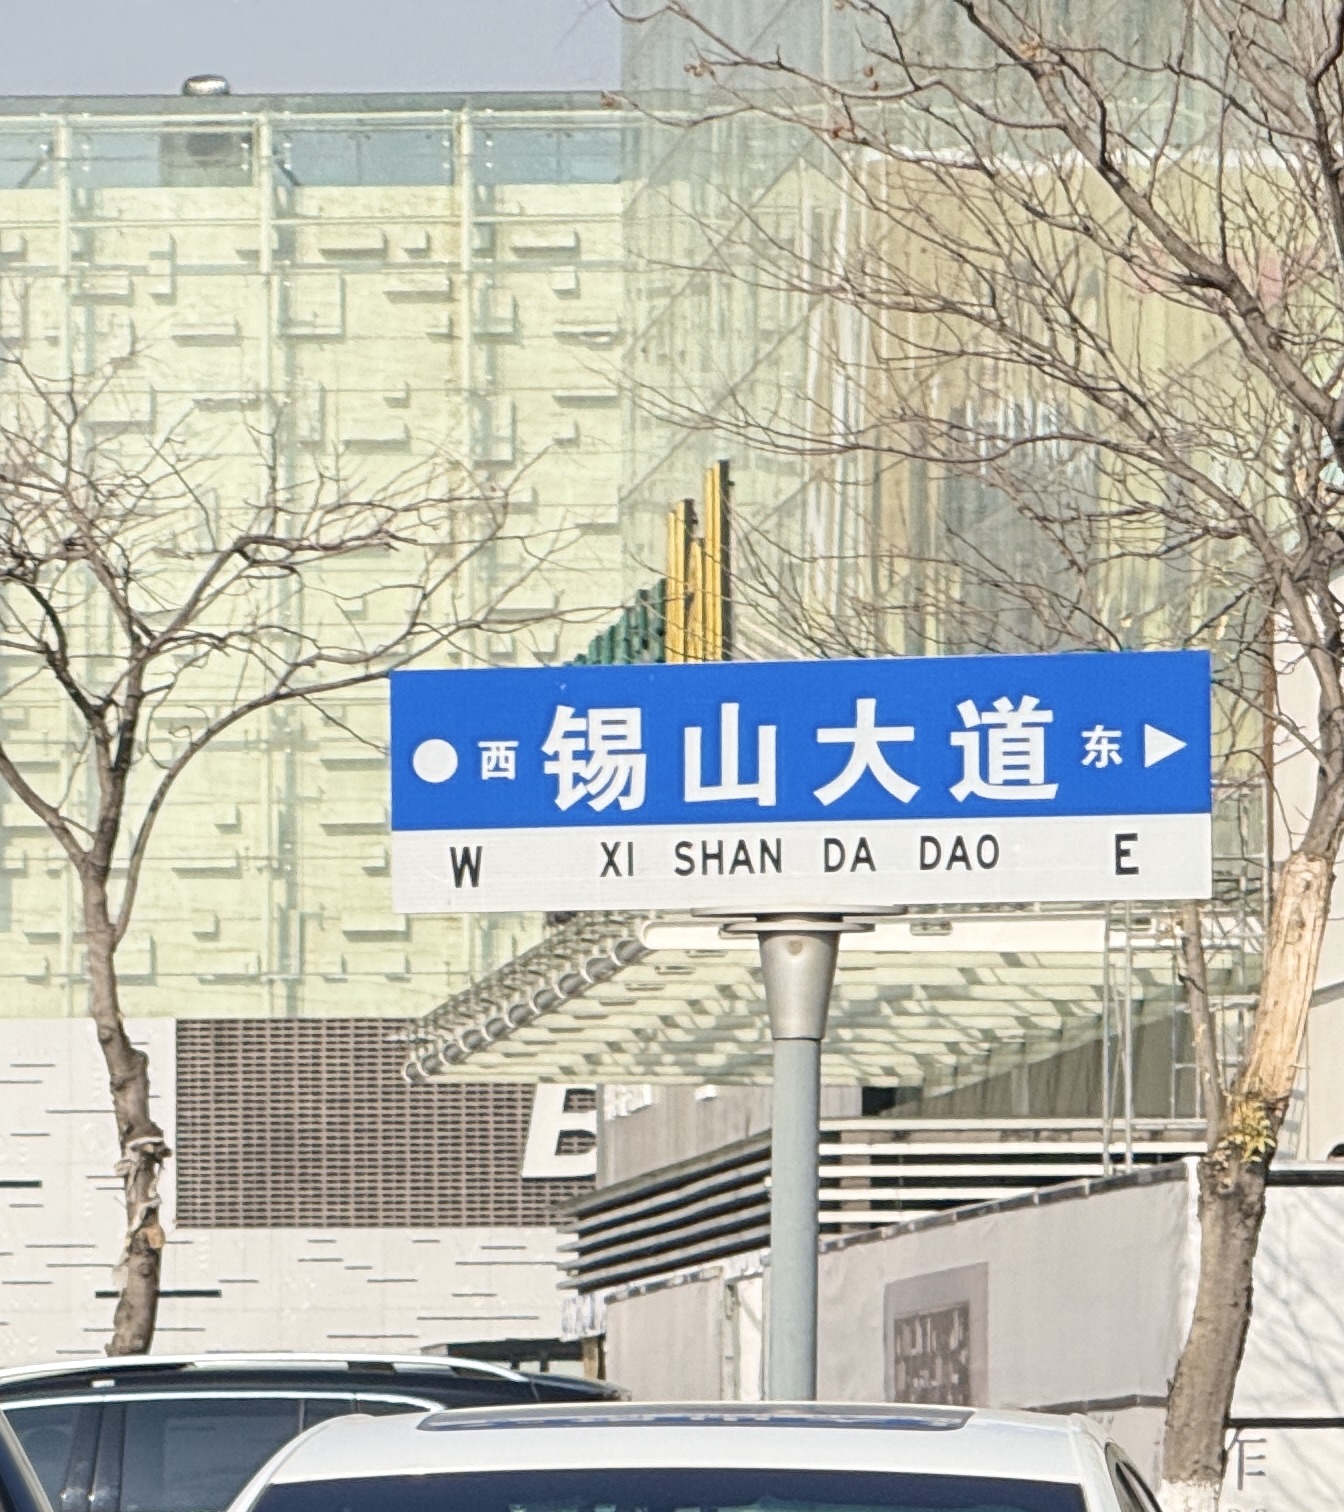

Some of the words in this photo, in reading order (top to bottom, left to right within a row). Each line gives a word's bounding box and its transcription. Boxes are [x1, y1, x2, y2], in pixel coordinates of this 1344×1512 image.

[479, 740, 518, 781] 西
[543, 695, 1059, 812] 锡山大道
[1081, 724, 1123, 768] 东
[449, 845, 483, 888] W
[600, 841, 634, 877] XI
[674, 837, 783, 876] SHAN
[824, 836, 877, 873] DA
[919, 833, 1001, 872] DAO
[1115, 833, 1139, 876] E
